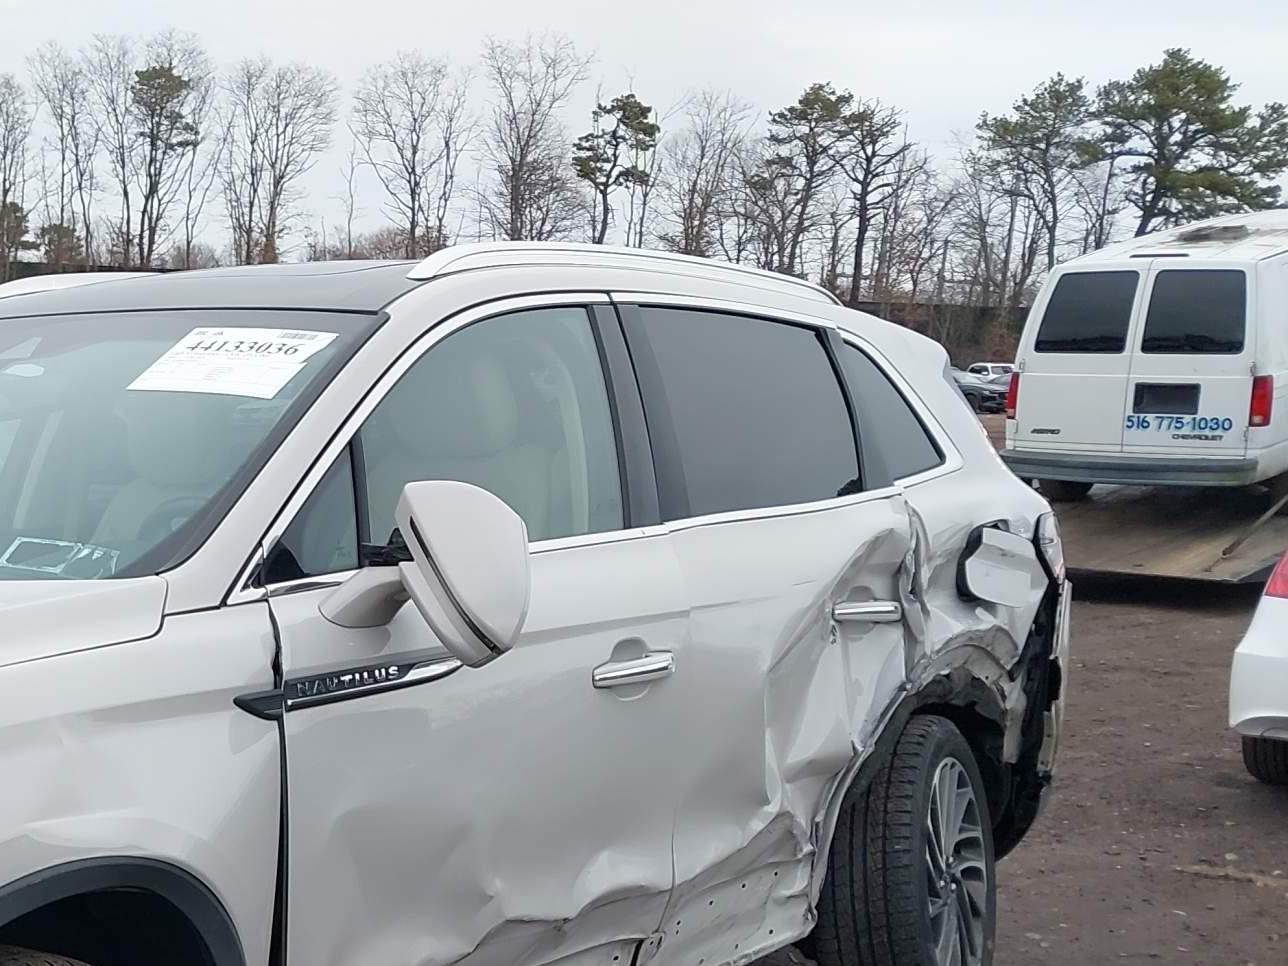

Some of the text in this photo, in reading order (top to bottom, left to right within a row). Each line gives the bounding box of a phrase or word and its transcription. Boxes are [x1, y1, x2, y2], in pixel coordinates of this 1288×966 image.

[186, 340, 304, 356] 44133036
[1125, 415, 1233, 431] 516 775-1030
[296, 665, 400, 697] NAUTILUS
